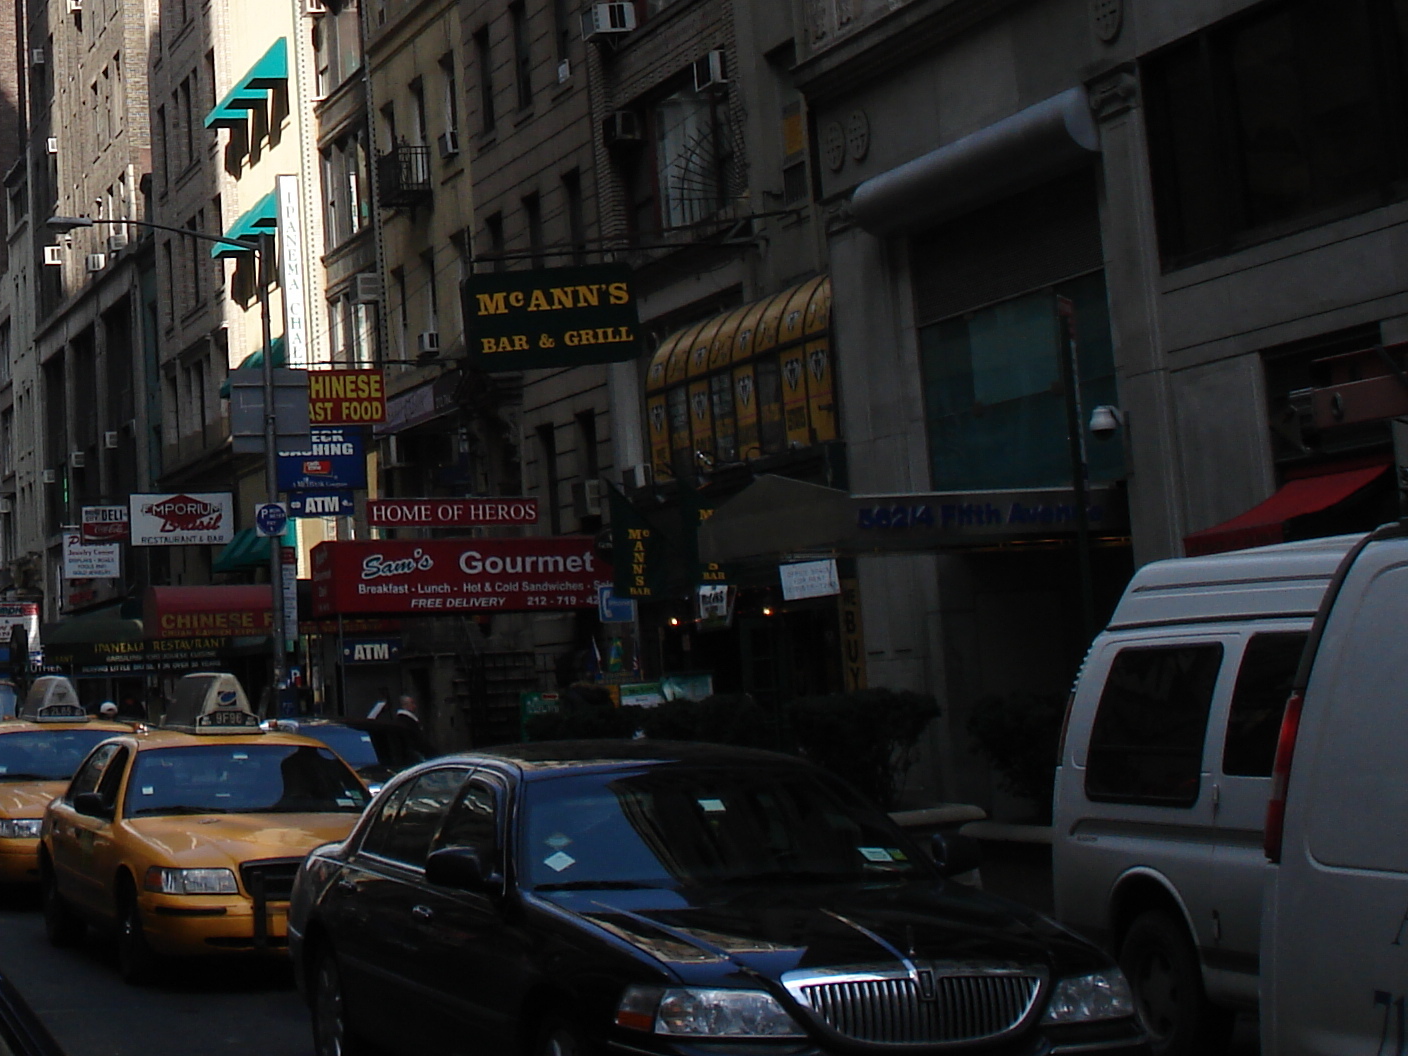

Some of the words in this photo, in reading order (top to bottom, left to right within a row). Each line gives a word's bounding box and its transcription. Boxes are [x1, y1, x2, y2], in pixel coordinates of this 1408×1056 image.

[286, 191, 300, 290] IPANEMA
[476, 282, 630, 317] McANN'S
[481, 334, 530, 354] BAR
[538, 333, 555, 349] &
[564, 326, 634, 347] GRILL
[308, 375, 382, 399] HINESE
[309, 402, 334, 421] AST
[343, 401, 382, 420] FOOD
[311, 430, 344, 442] ECK
[278, 443, 354, 457] HING
[142, 503, 222, 516] EMPORIUM
[305, 496, 340, 514] ATM
[373, 505, 432, 522] HOME
[439, 504, 465, 521] OF
[470, 502, 537, 521] HEROS
[101, 509, 123, 521] DELI
[261, 508, 269, 520] P
[940, 502, 1001, 527] Fifth
[141, 535, 196, 544] RESTAURANT
[207, 535, 224, 543] BAR
[361, 548, 435, 580] Sam's
[459, 550, 594, 575] Gourmet
[702, 571, 726, 581] BAR
[358, 583, 409, 595] Breakfast
[417, 583, 451, 594] Lunch
[463, 582, 482, 593] Hot
[485, 583, 492, 592] &
[495, 582, 520, 592] Cold
[522, 580, 584, 592] Sandwiches
[630, 587, 652, 596] BAR
[411, 597, 442, 609] FREE
[446, 597, 506, 608] DELIVERY
[527, 596, 547, 606] 212
[557, 595, 577, 605] 719
[162, 612, 254, 629] CHINESE
[153, 637, 226, 652] RESTAURANT
[354, 644, 390, 661] ATM
